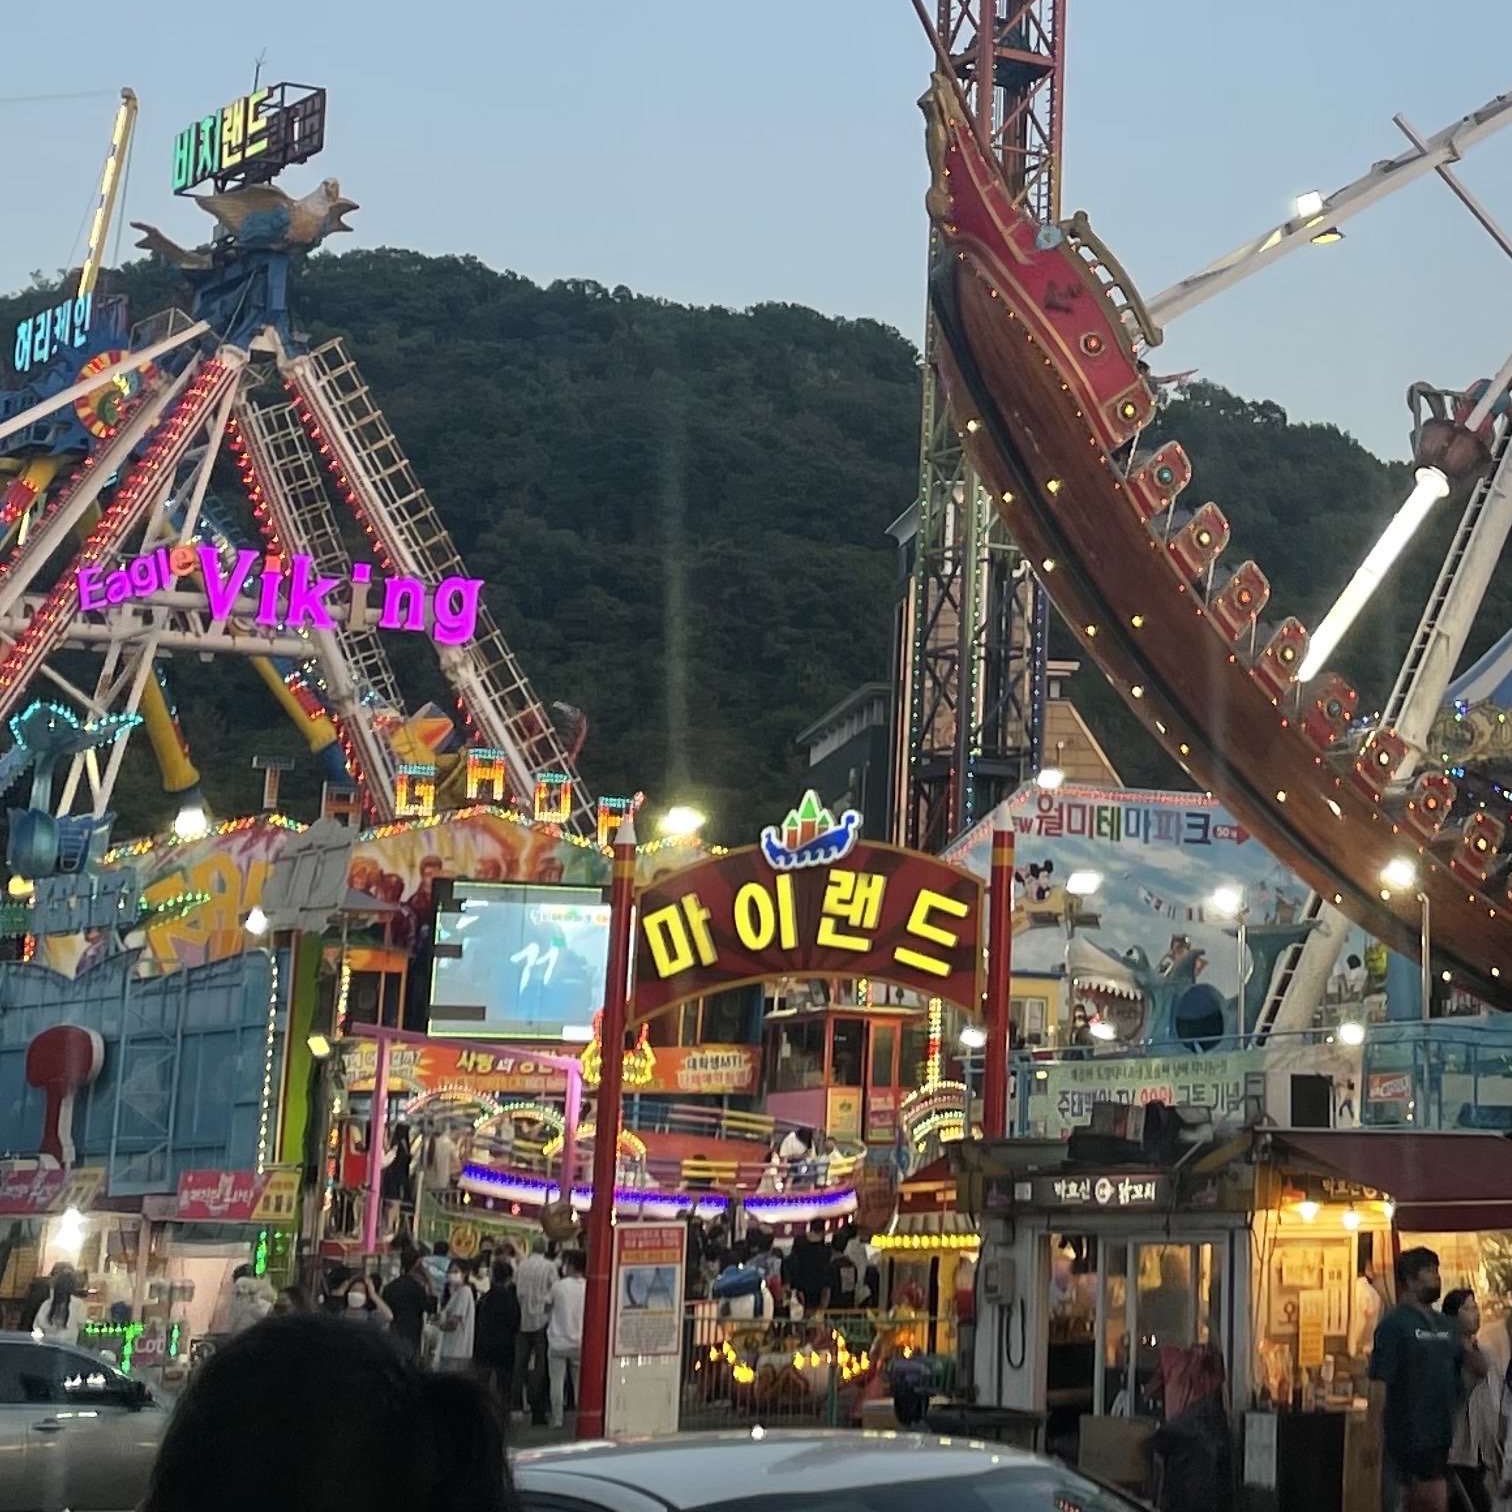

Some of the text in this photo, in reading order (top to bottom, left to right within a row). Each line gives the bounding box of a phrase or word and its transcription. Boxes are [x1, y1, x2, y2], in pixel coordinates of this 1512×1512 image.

[172, 88, 269, 190] 비치랜드
[78, 544, 484, 646] Eagle Viking
[1036, 792, 1212, 846] 월미테마파크
[642, 870, 968, 978] 마이랜드
